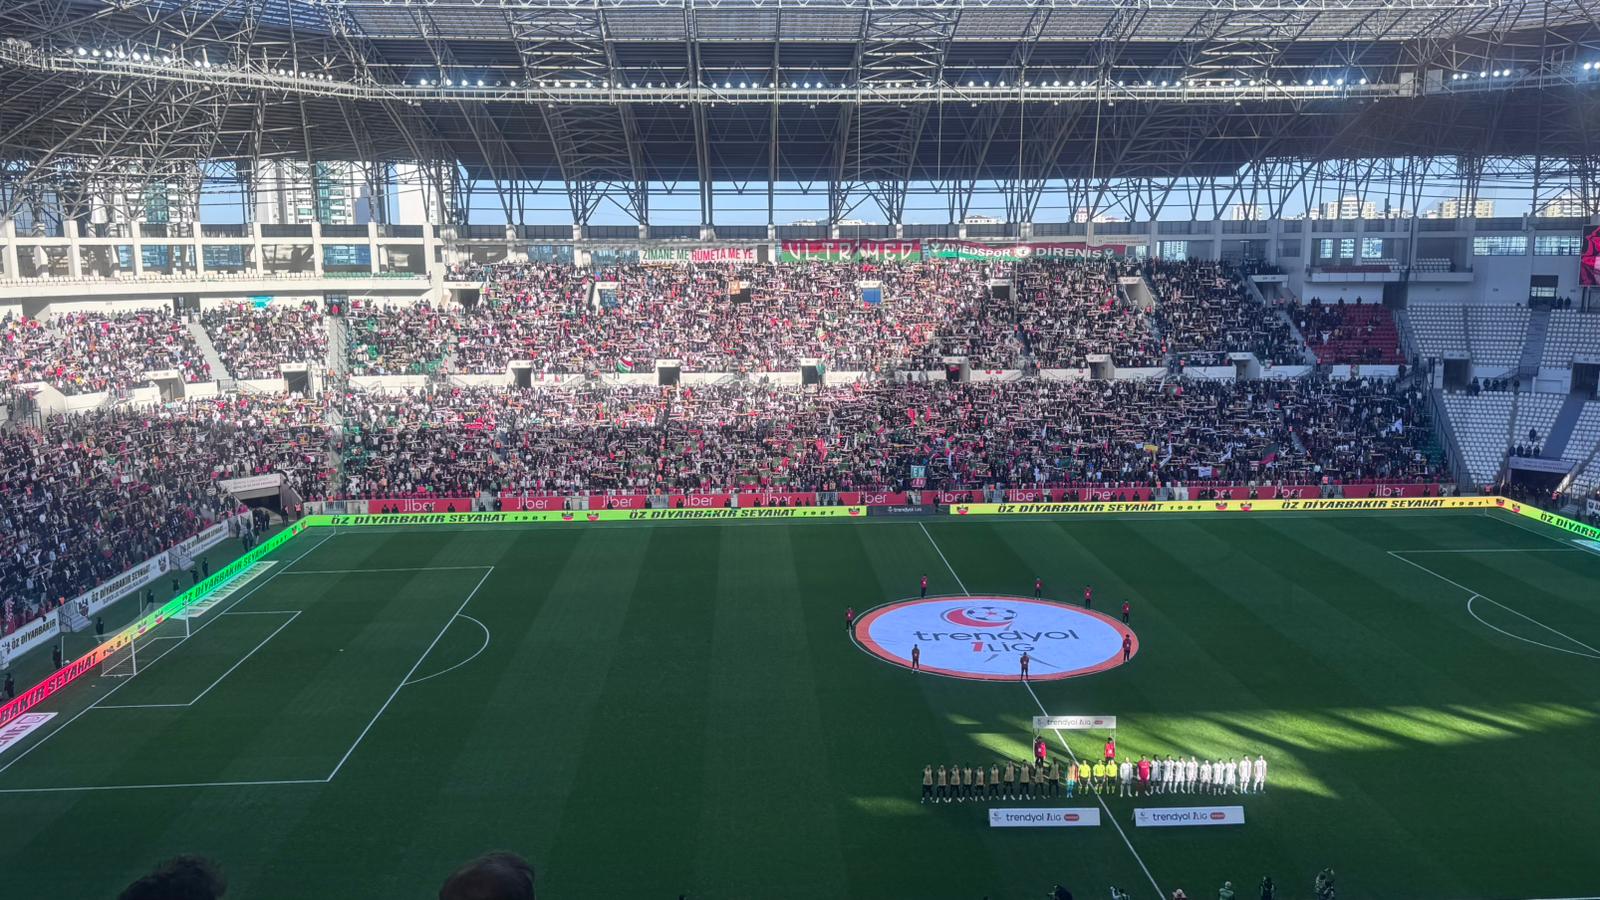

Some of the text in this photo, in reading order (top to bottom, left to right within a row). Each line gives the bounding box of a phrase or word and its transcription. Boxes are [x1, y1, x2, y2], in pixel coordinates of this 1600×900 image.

[677, 249, 689, 260] ME
[728, 247, 741, 259] ME
[942, 243, 1011, 258] AMEDSPOR
[1019, 503, 1104, 513] DİYARBAKIR
[1107, 503, 1164, 512] SEYAHAT
[1303, 500, 1387, 509] DİYARBAKIR
[1391, 499, 1445, 508] SEYAHAT
[354, 514, 446, 525] DİYARBAKIR
[449, 512, 508, 523] SEYAHAT
[651, 508, 737, 519] DİYARBAKIR
[740, 508, 797, 518] SEYAHAT
[1541, 511, 1553, 524] ÖZ
[243, 542, 271, 567] SEYAHAT
[20, 618, 56, 645] DİYARBAKIR
[913, 629, 1080, 642] trendyol
[48, 652, 99, 693] SEYAHAT
[1047, 719, 1077, 727] trendyol
[1006, 813, 1044, 823] trendyol
[1153, 812, 1191, 822] trendyol
